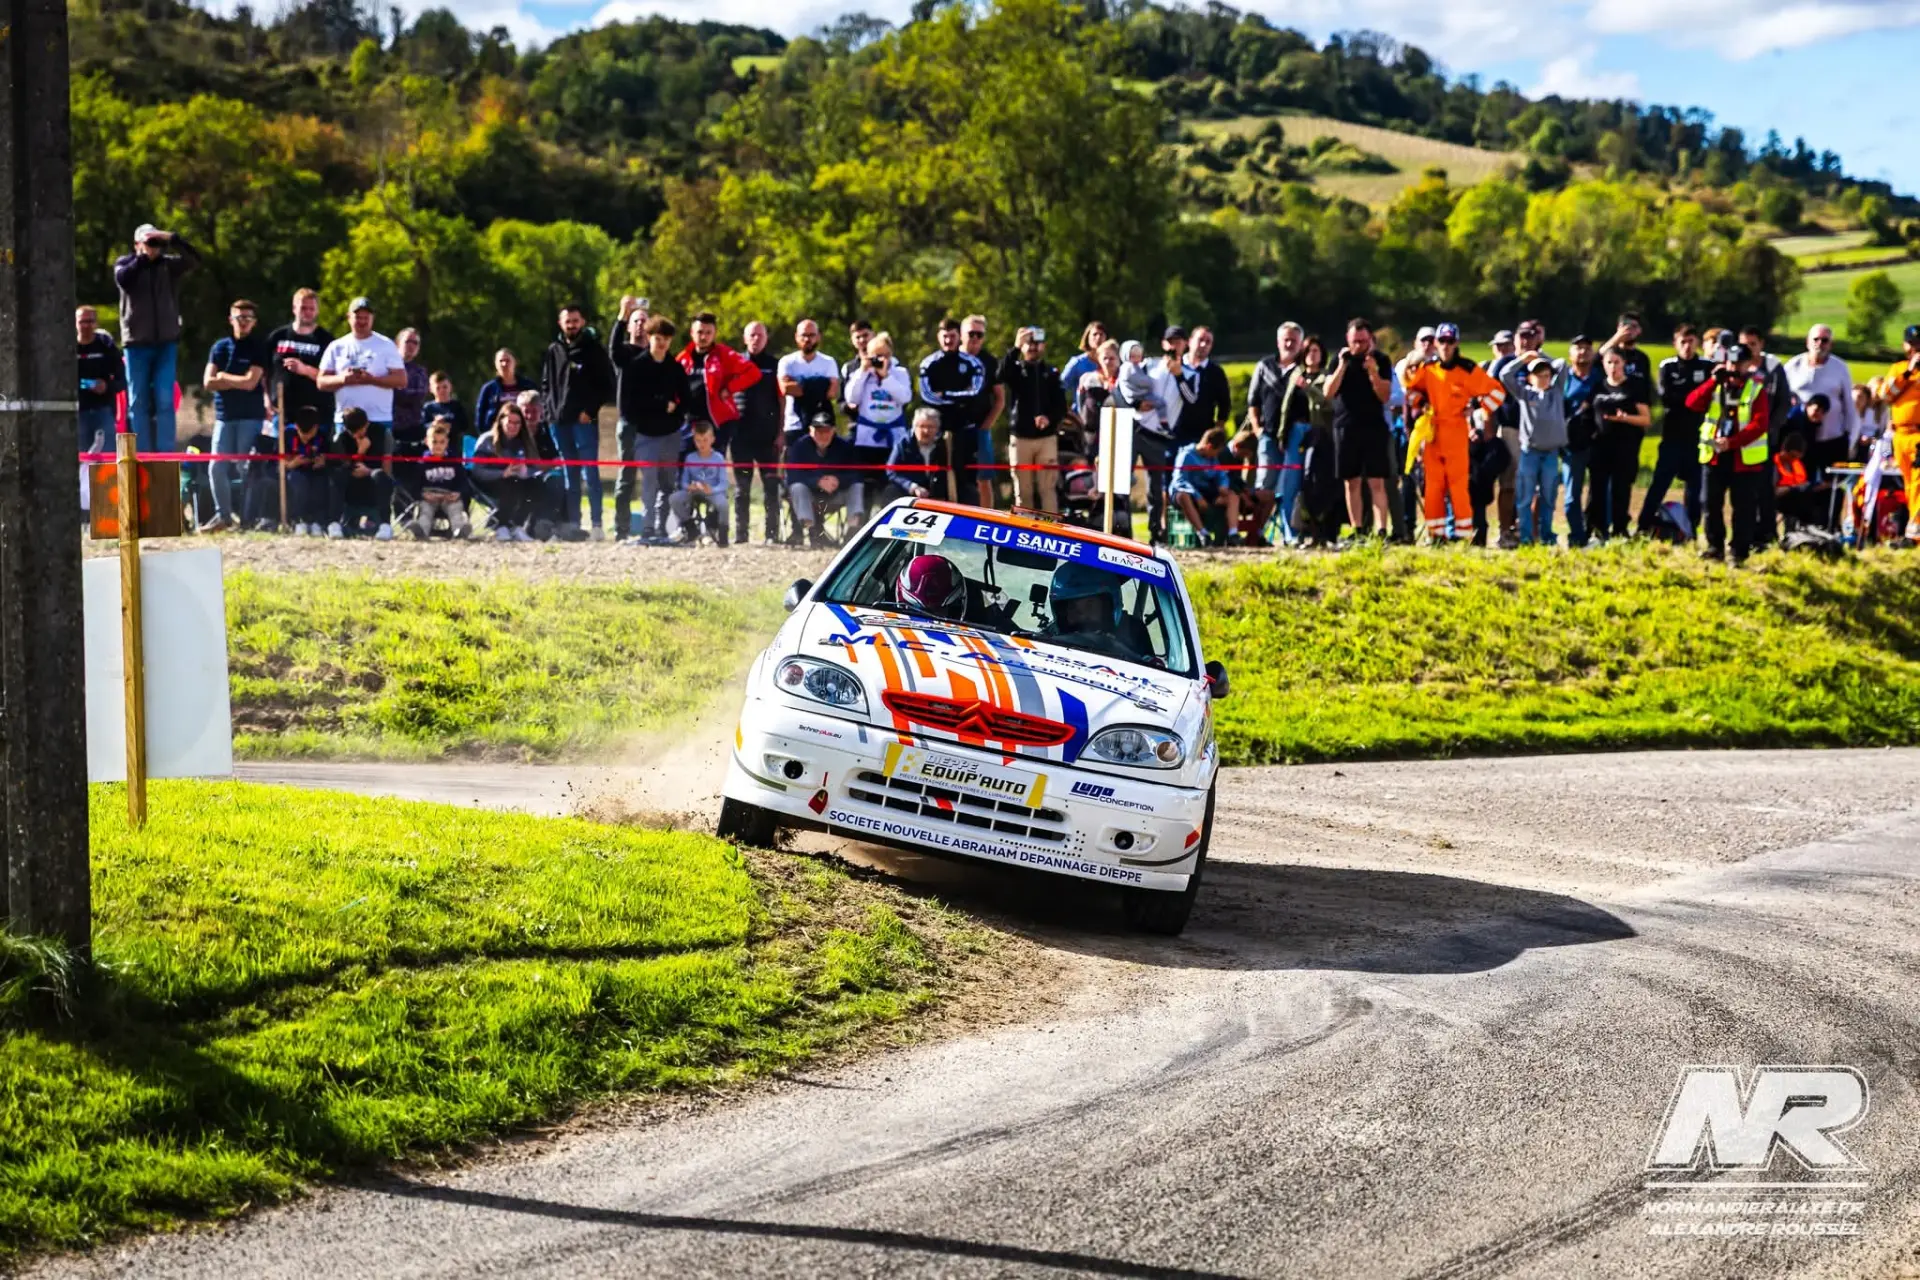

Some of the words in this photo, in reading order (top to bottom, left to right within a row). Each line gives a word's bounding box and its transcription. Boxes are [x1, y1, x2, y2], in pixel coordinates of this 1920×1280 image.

[903, 511, 939, 529] 64
[974, 524, 1012, 544] EU
[1016, 532, 1082, 557] SANTÉ
[925, 755, 980, 774] DIEPPE
[921, 763, 1028, 795] EQUIP'AUTO
[1099, 795, 1154, 812] CONCEPTION
[829, 810, 882, 831] SOCIETE
[883, 822, 951, 846] NOUVELLE
[951, 838, 1018, 860] ABRAHAM
[1019, 851, 1097, 875] DEPANNAGE
[1099, 866, 1143, 883] DIEPPE
